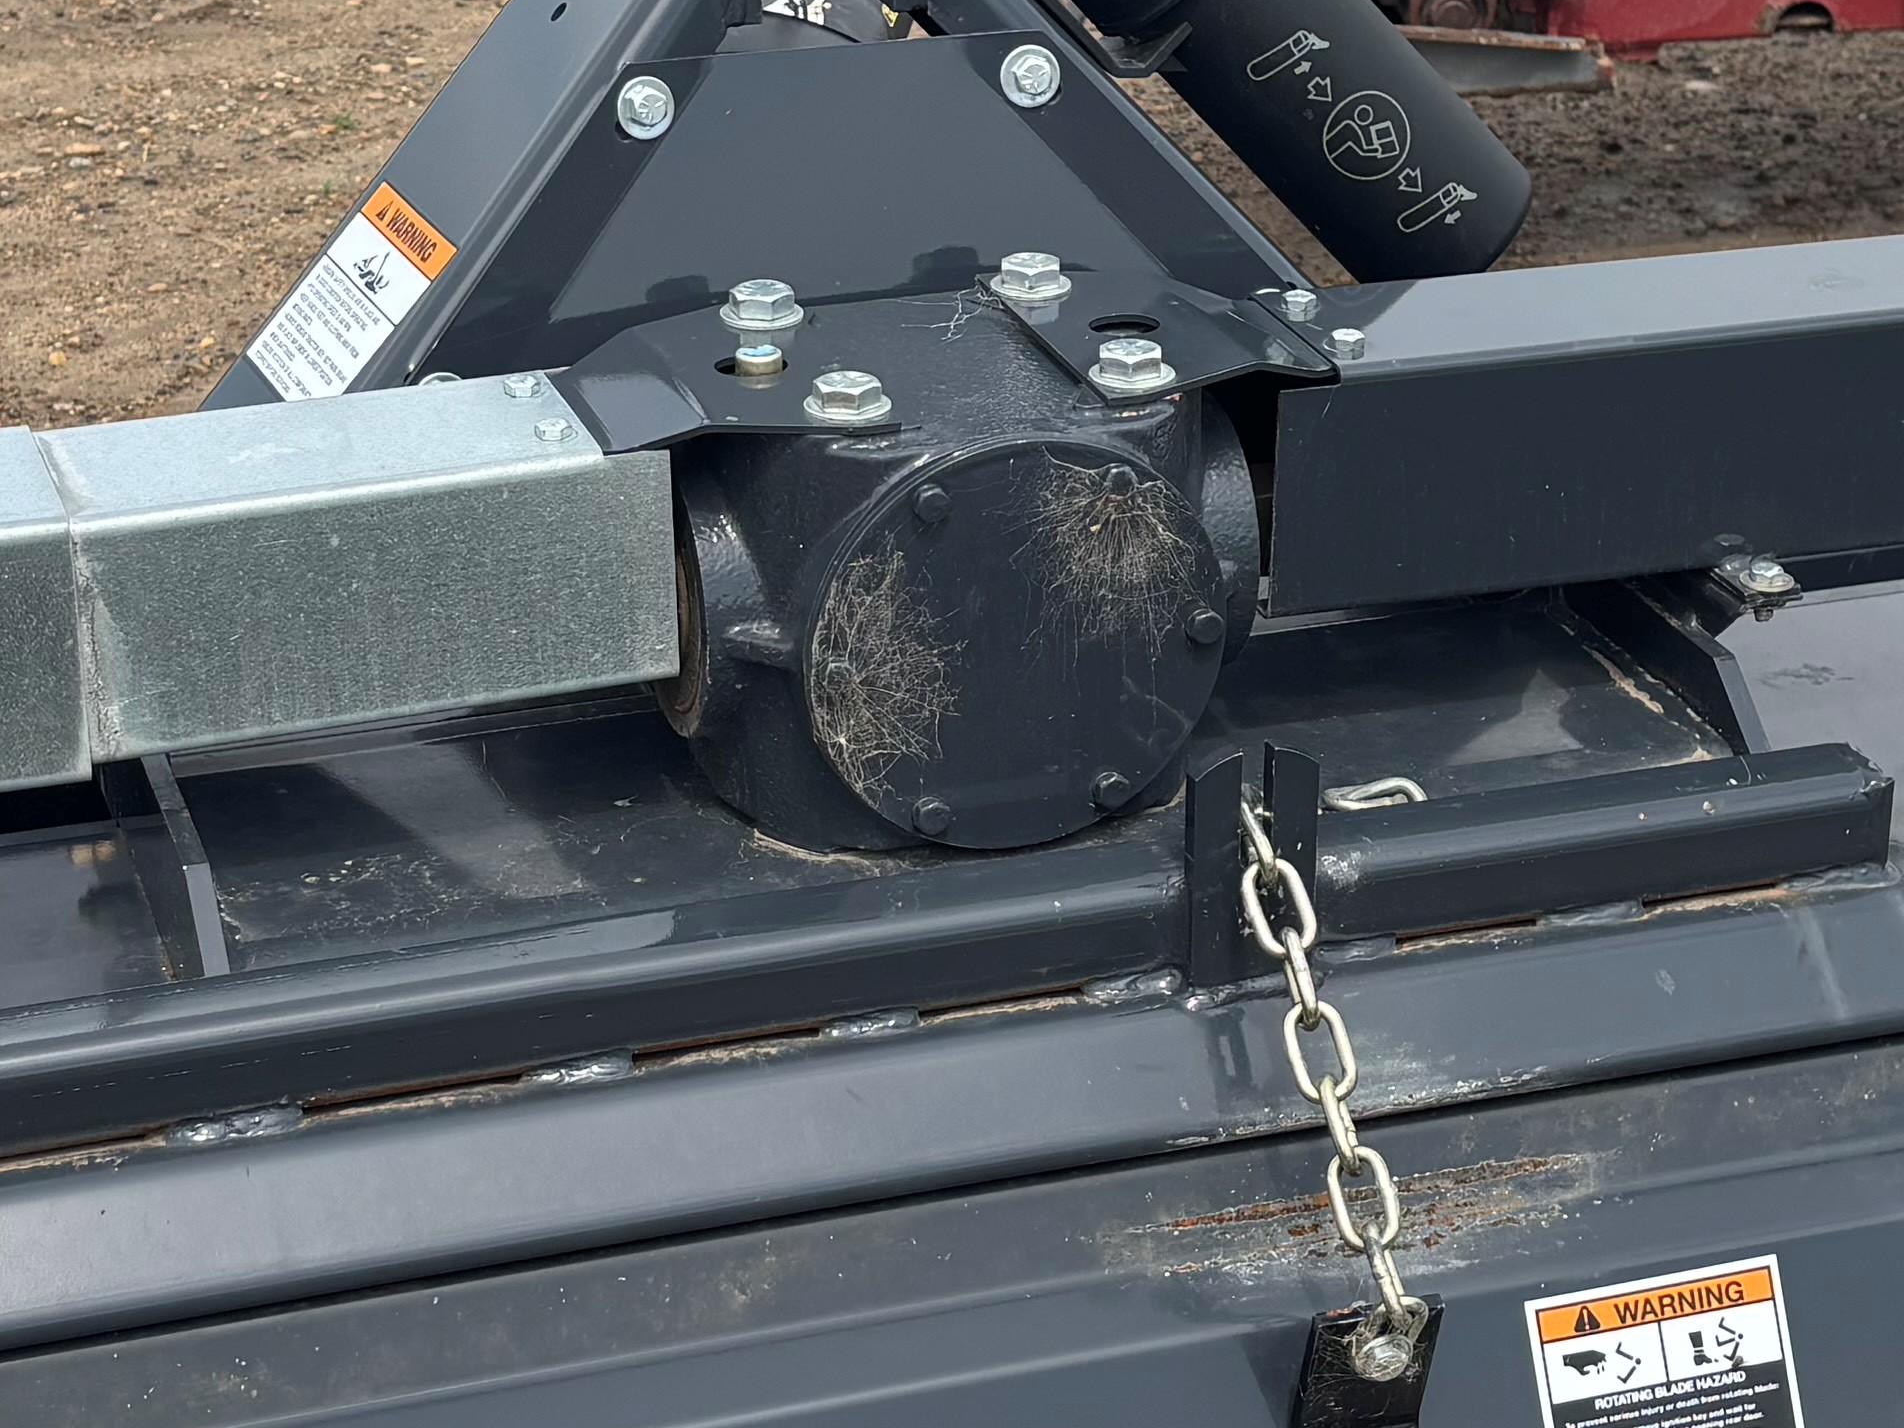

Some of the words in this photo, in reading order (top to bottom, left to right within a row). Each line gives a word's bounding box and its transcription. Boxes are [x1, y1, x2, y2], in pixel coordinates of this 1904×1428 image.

[386, 209, 438, 263] WARNING
[1613, 1280, 1745, 1325] WARNING
[1594, 1388, 1654, 1410] ROTATING
[1653, 1379, 1695, 1399] BLADE
[1695, 1370, 1746, 1390] HAZARD
